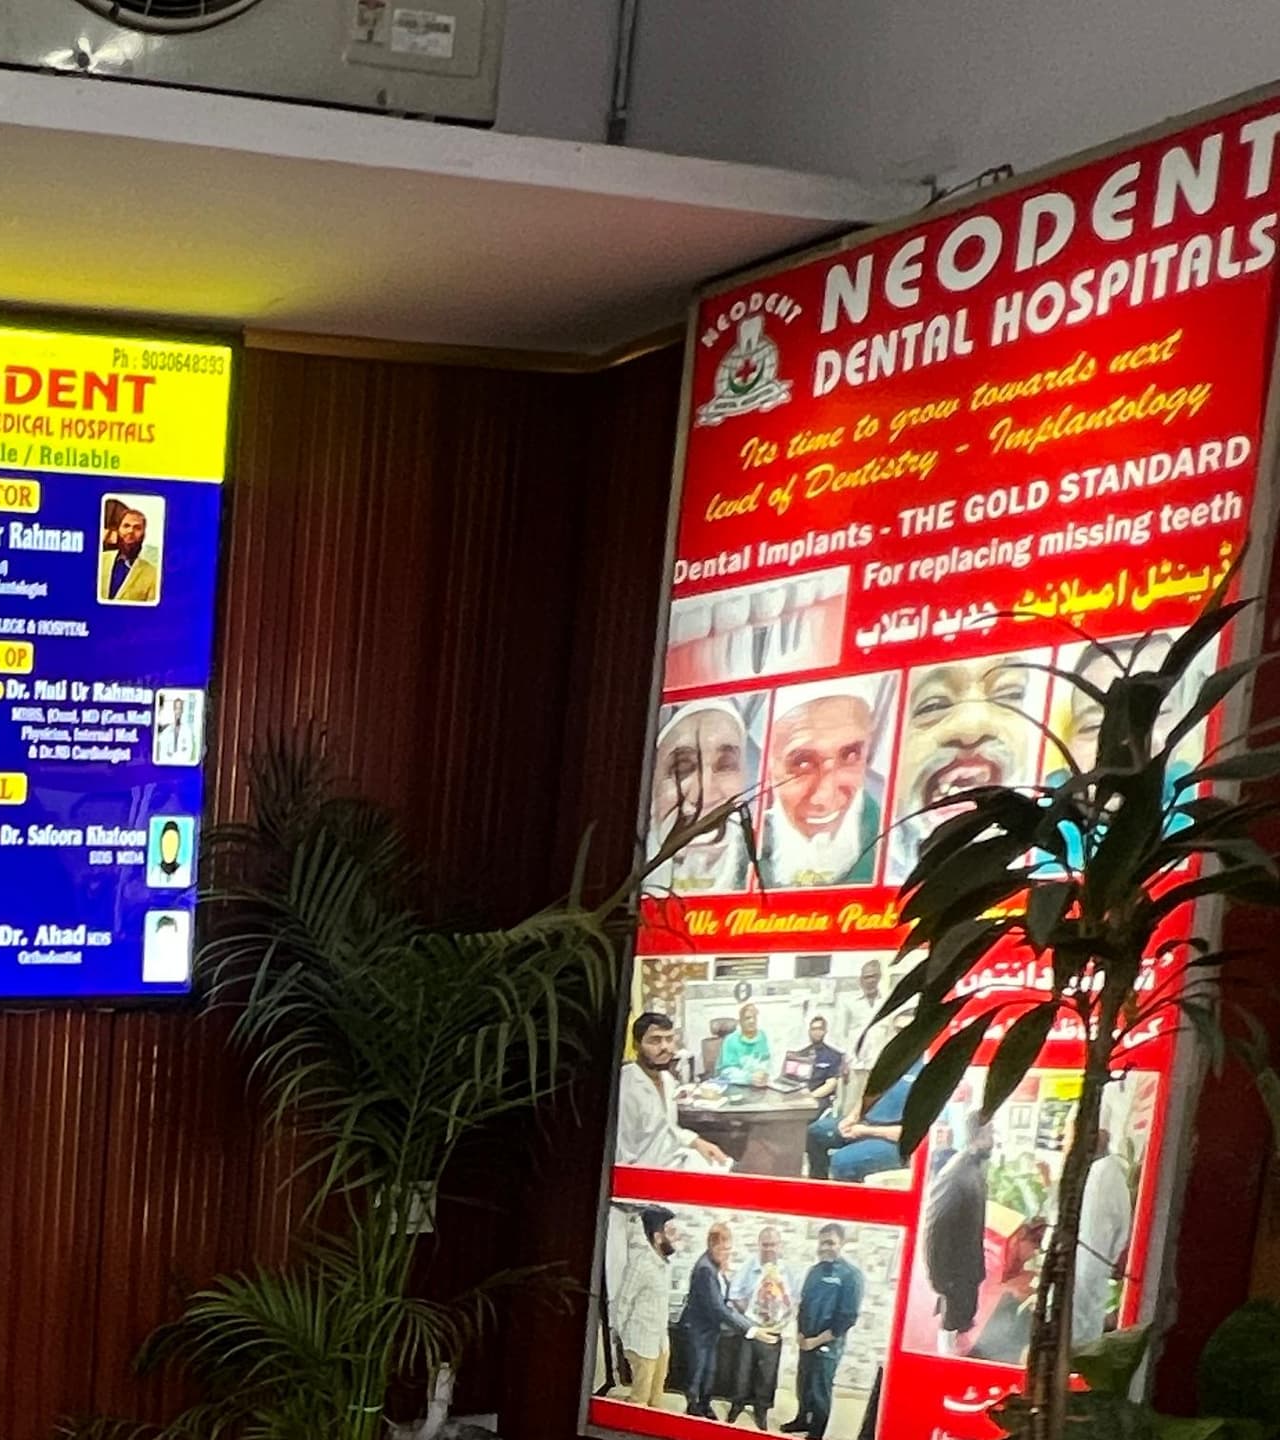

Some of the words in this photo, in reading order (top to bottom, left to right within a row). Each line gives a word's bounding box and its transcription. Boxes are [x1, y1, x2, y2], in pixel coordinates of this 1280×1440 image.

[820, 112, 1280, 334] NEODENT
[701, 292, 803, 347] NEODENT
[812, 307, 974, 398] DENTAL
[991, 212, 1280, 350] HOSPITALS
[112, 348, 129, 369] Ph
[740, 437, 778, 470] Its
[787, 427, 845, 459] time
[853, 414, 879, 442] to
[889, 398, 960, 443] grow
[970, 351, 1097, 411] towards
[1109, 328, 1183, 373] next
[60, 418, 155, 443] HOSPITALS
[23, 444, 33, 466] /
[40, 446, 120, 470] Reliable
[705, 483, 763, 522] level
[768, 473, 798, 515] of
[805, 450, 938, 500] Dentistry
[989, 382, 1213, 454] Implantology
[673, 545, 750, 585] Dental
[757, 523, 873, 566] Implants
[898, 500, 957, 538] THE
[963, 479, 1051, 524] GOLD
[1056, 434, 1252, 504] STANDARD
[9, 522, 84, 553] Rahman
[862, 561, 904, 590] For
[907, 534, 1034, 582] replacing
[1038, 509, 1153, 557] missing
[1159, 490, 1243, 534] teeth
[37, 620, 89, 636] HOSPITAL
[4, 647, 27, 668] OP
[6, 679, 30, 699] Dr.
[71, 681, 89, 702] Ur
[92, 682, 154, 704] Rahman
[0, 824, 23, 846] Dr.
[725, 907, 829, 937] Maintain
